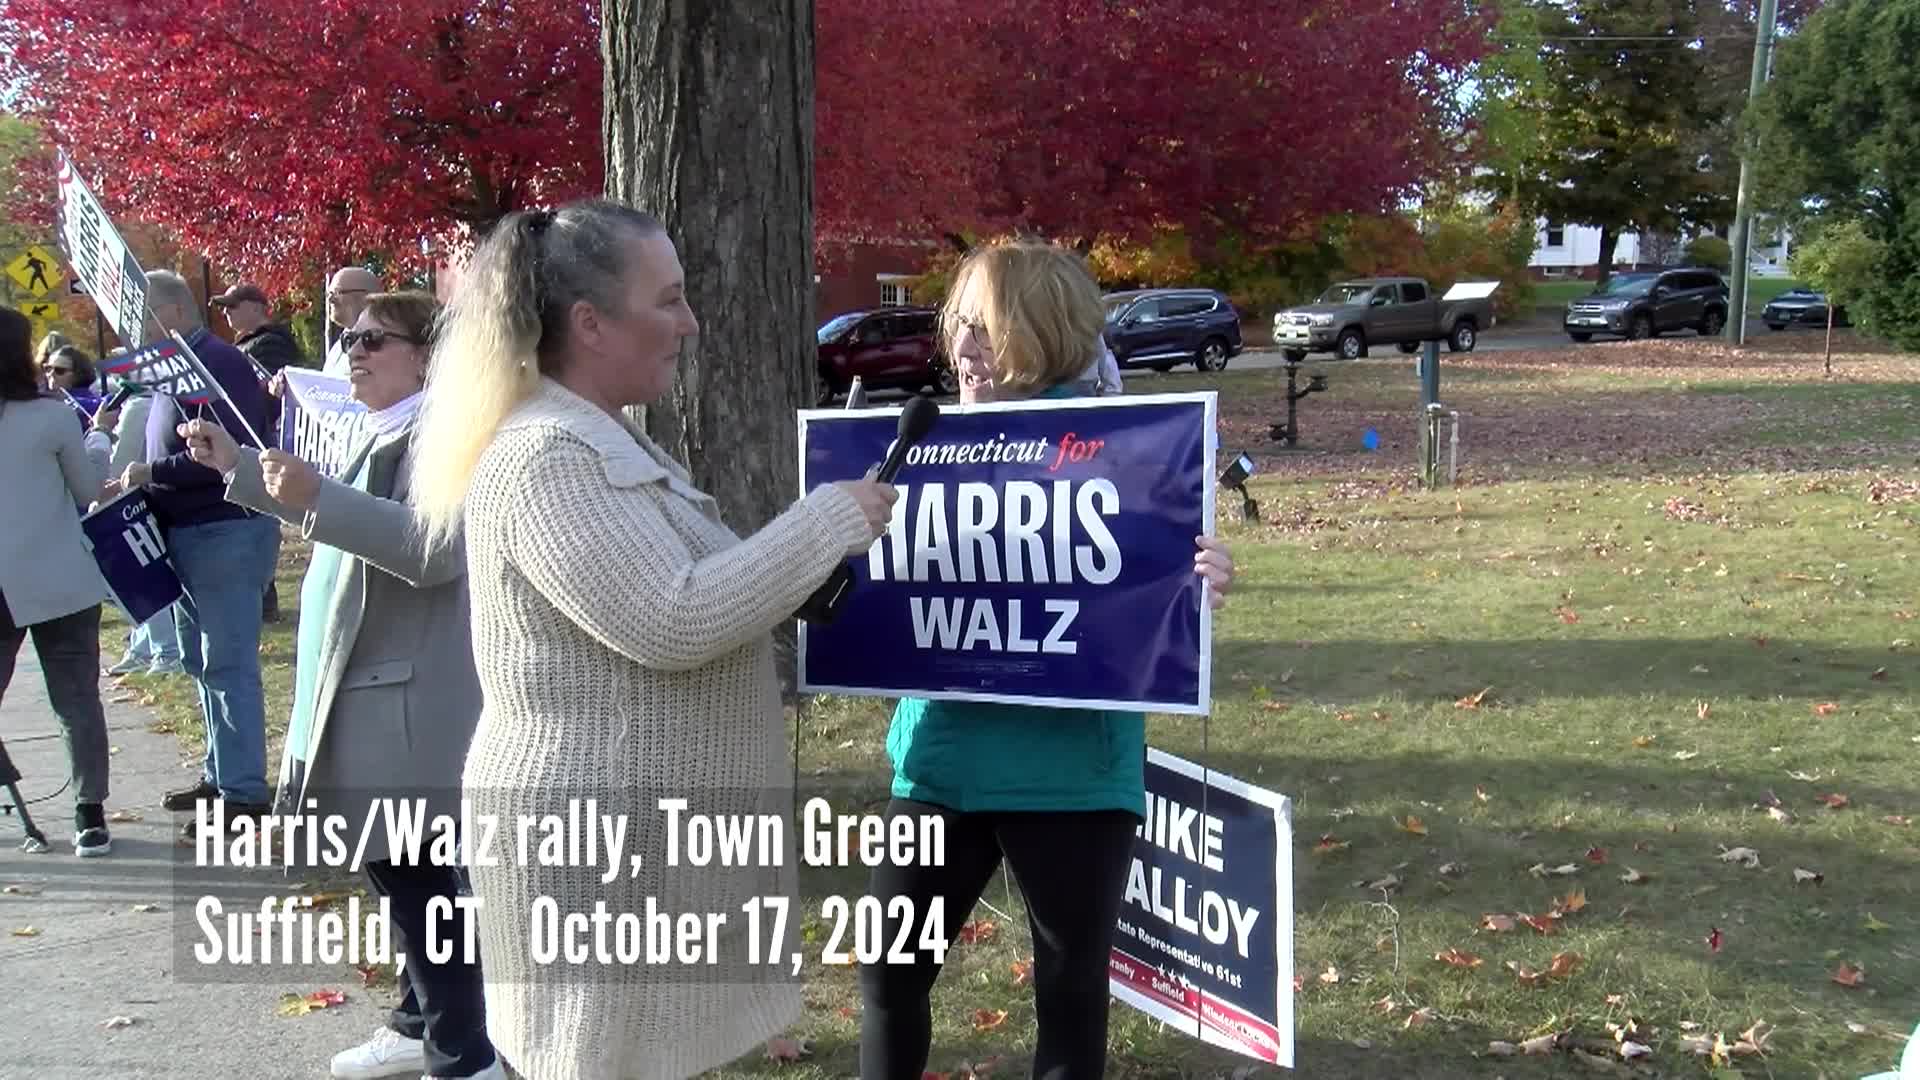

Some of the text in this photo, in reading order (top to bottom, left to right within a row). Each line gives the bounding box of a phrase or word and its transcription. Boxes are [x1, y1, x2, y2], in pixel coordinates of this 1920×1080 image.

[79, 193, 101, 297] HARRIS
[1049, 432, 1105, 471] for
[909, 597, 1080, 655] WALZ
[1138, 927, 1213, 974] Representative
[1216, 964, 1243, 989] 61st
[1151, 976, 1185, 1003] Suffield
